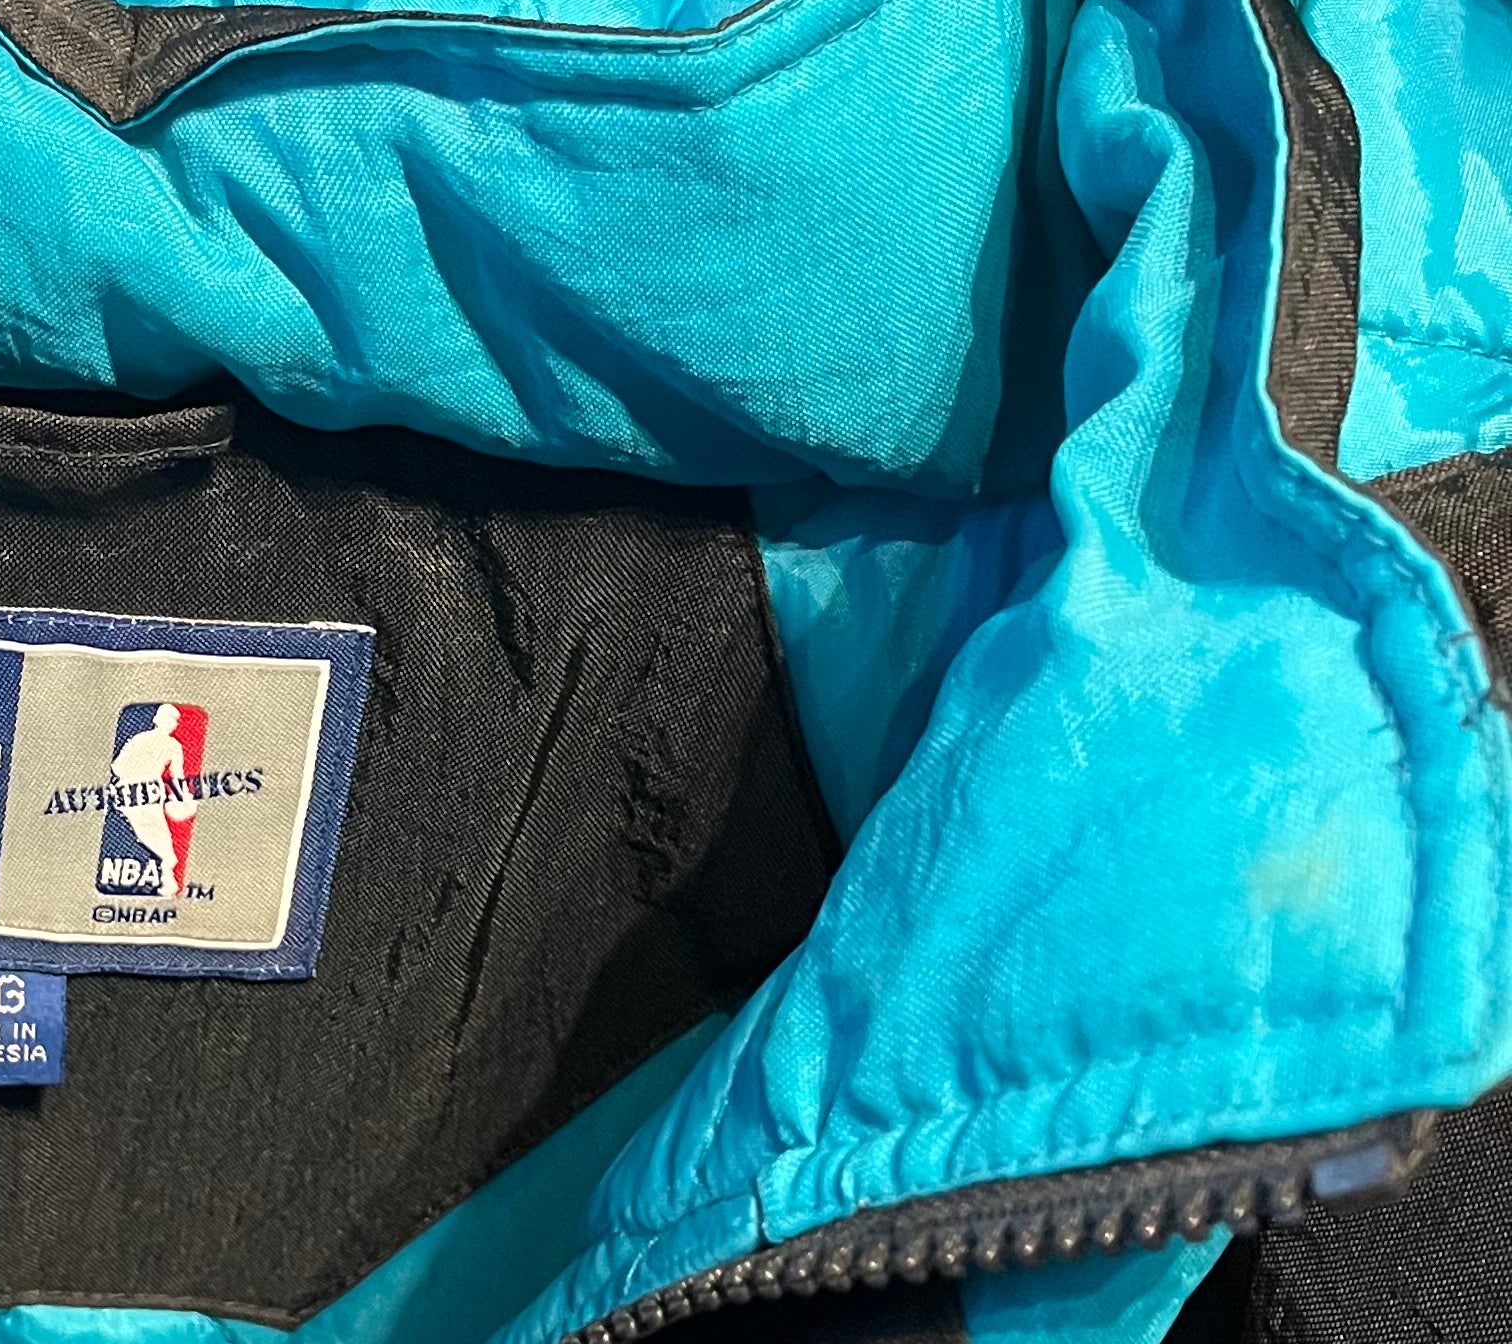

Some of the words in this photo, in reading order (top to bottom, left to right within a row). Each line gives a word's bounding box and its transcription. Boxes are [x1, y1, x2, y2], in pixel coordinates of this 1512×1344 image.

[43, 768, 264, 815] AUTHENTICS
[100, 857, 161, 887] NBA
[13, 1022, 37, 1041] IN
